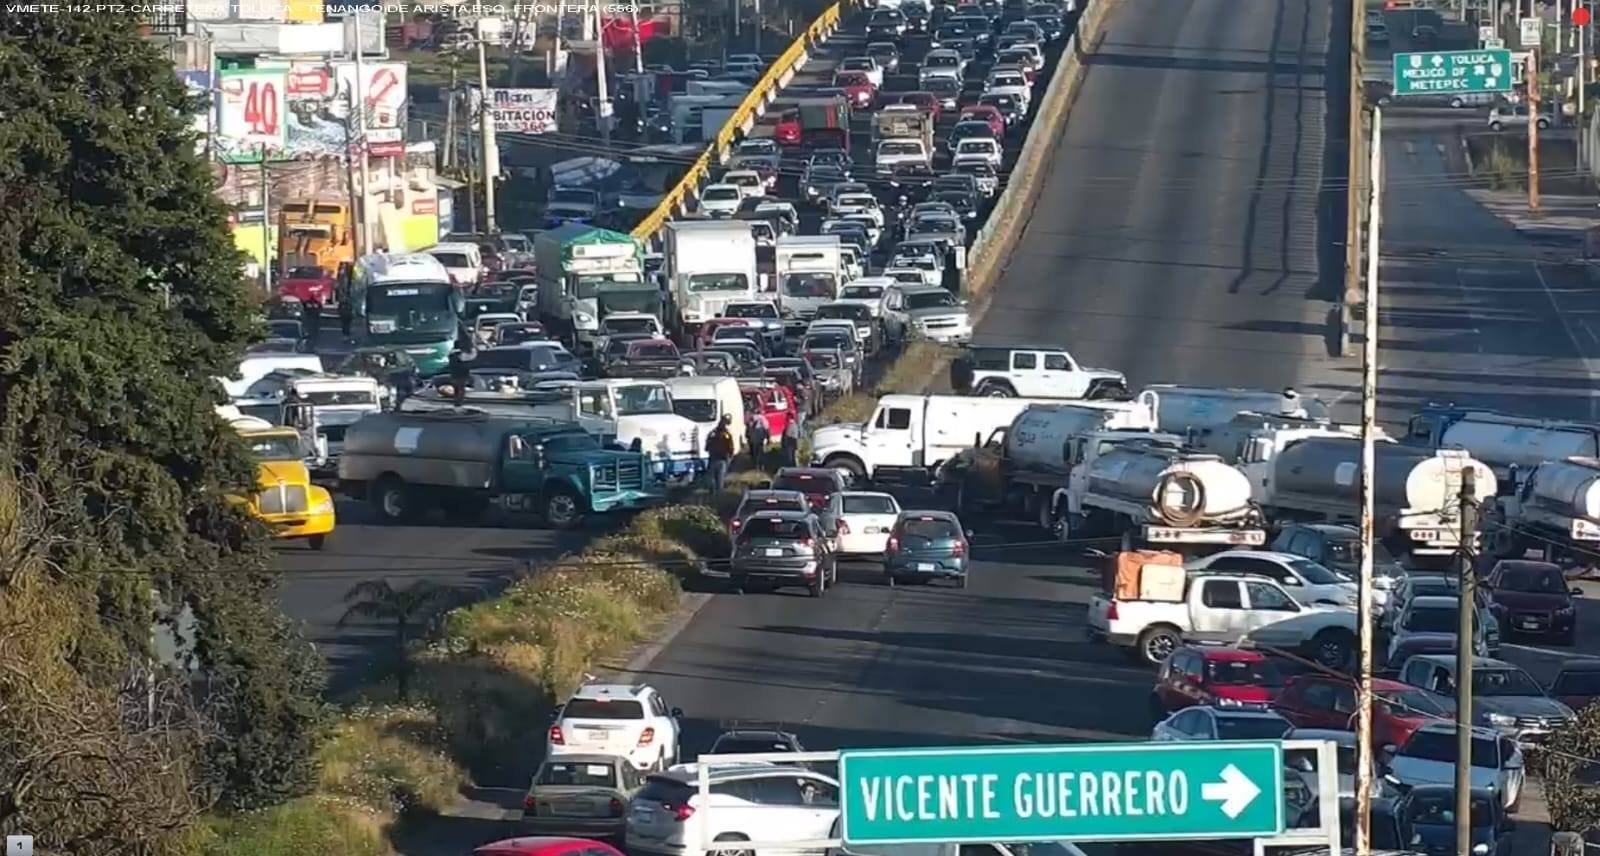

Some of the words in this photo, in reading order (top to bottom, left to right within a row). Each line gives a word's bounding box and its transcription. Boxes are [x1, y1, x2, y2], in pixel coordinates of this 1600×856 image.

[1450, 54, 1495, 65] TOLUCA
[1410, 79, 1469, 90] METEPEC
[244, 82, 277, 135] 40
[493, 110, 556, 121] BITACION
[860, 774, 1000, 821] VICENTE
[1014, 769, 1188, 818] GUERRERO
